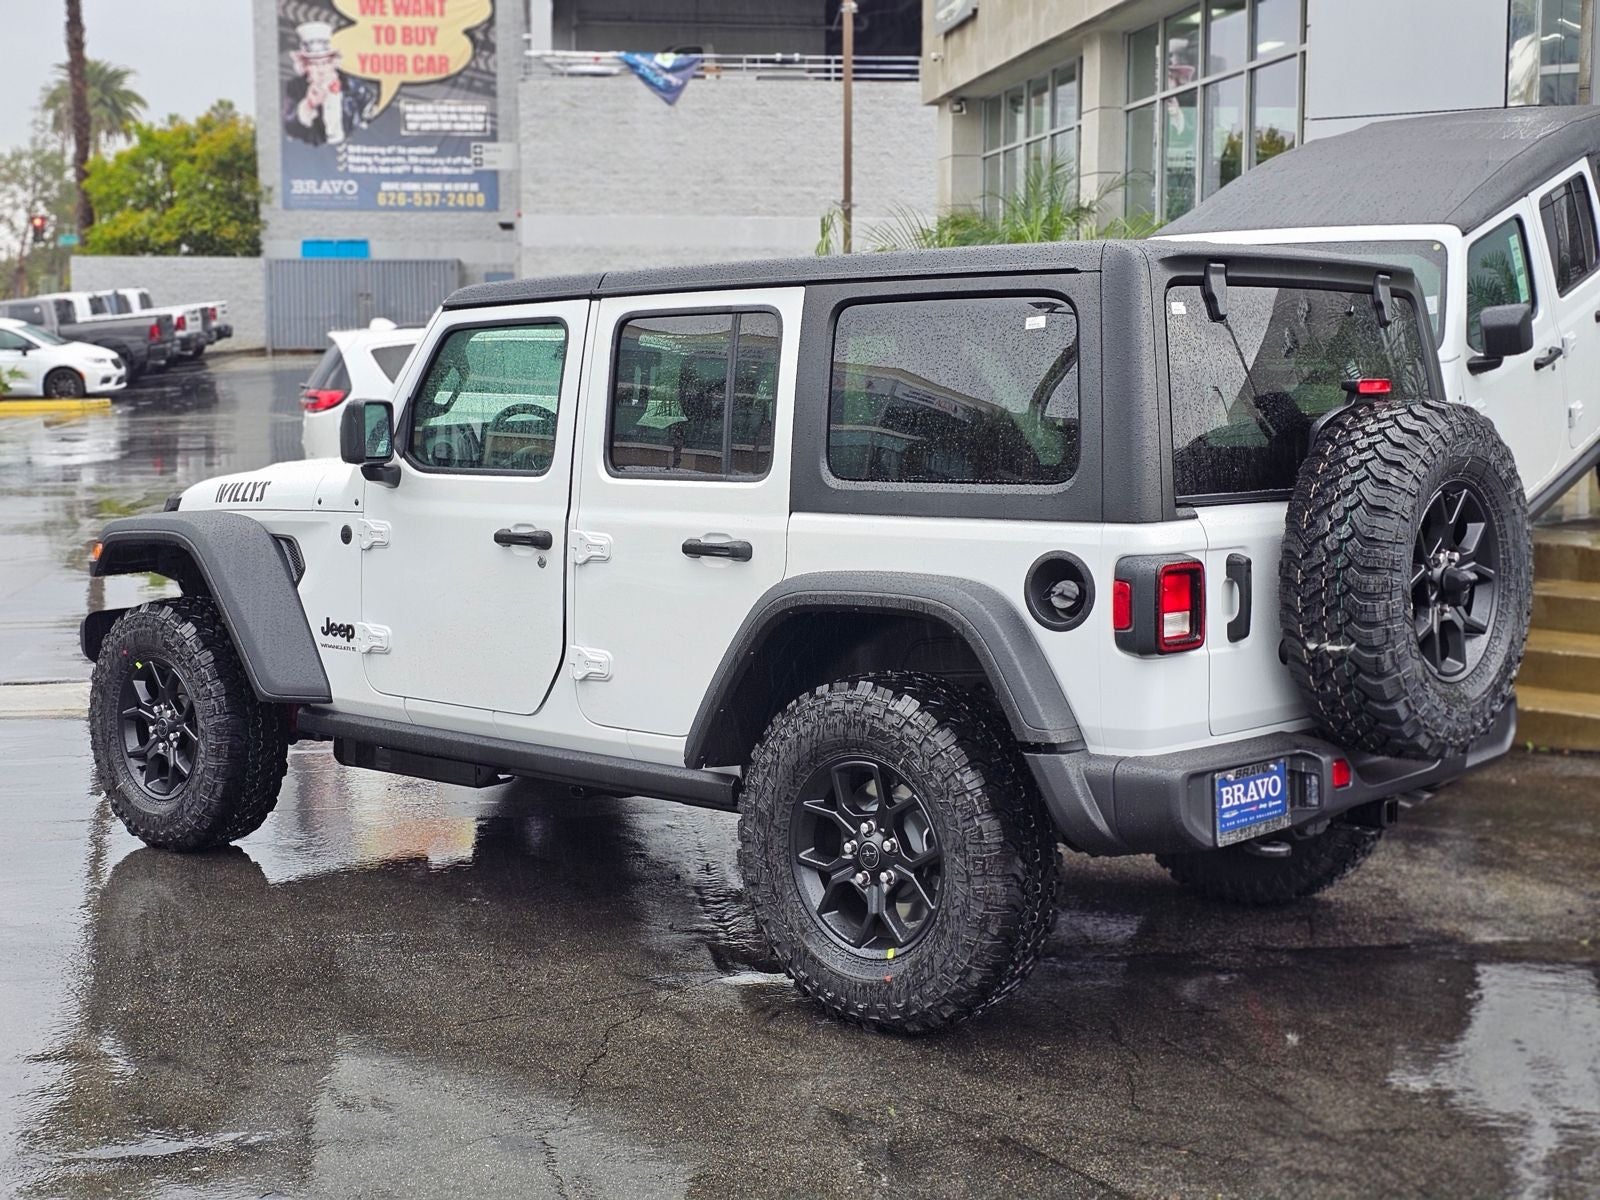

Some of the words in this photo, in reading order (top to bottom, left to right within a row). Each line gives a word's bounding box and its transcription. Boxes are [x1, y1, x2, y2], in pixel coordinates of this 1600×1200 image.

[358, 0, 387, 16] WE
[392, 0, 446, 17] WANT
[372, 25, 396, 46] TO
[401, 25, 438, 46] BUY
[358, 53, 407, 74] YOUR
[412, 53, 449, 75] CAR
[291, 179, 358, 195] BRAVO
[215, 481, 272, 503] WILLYS
[320, 616, 355, 643] Jeep
[1235, 763, 1269, 780] BRAVO
[1221, 775, 1282, 809] BRAVO
